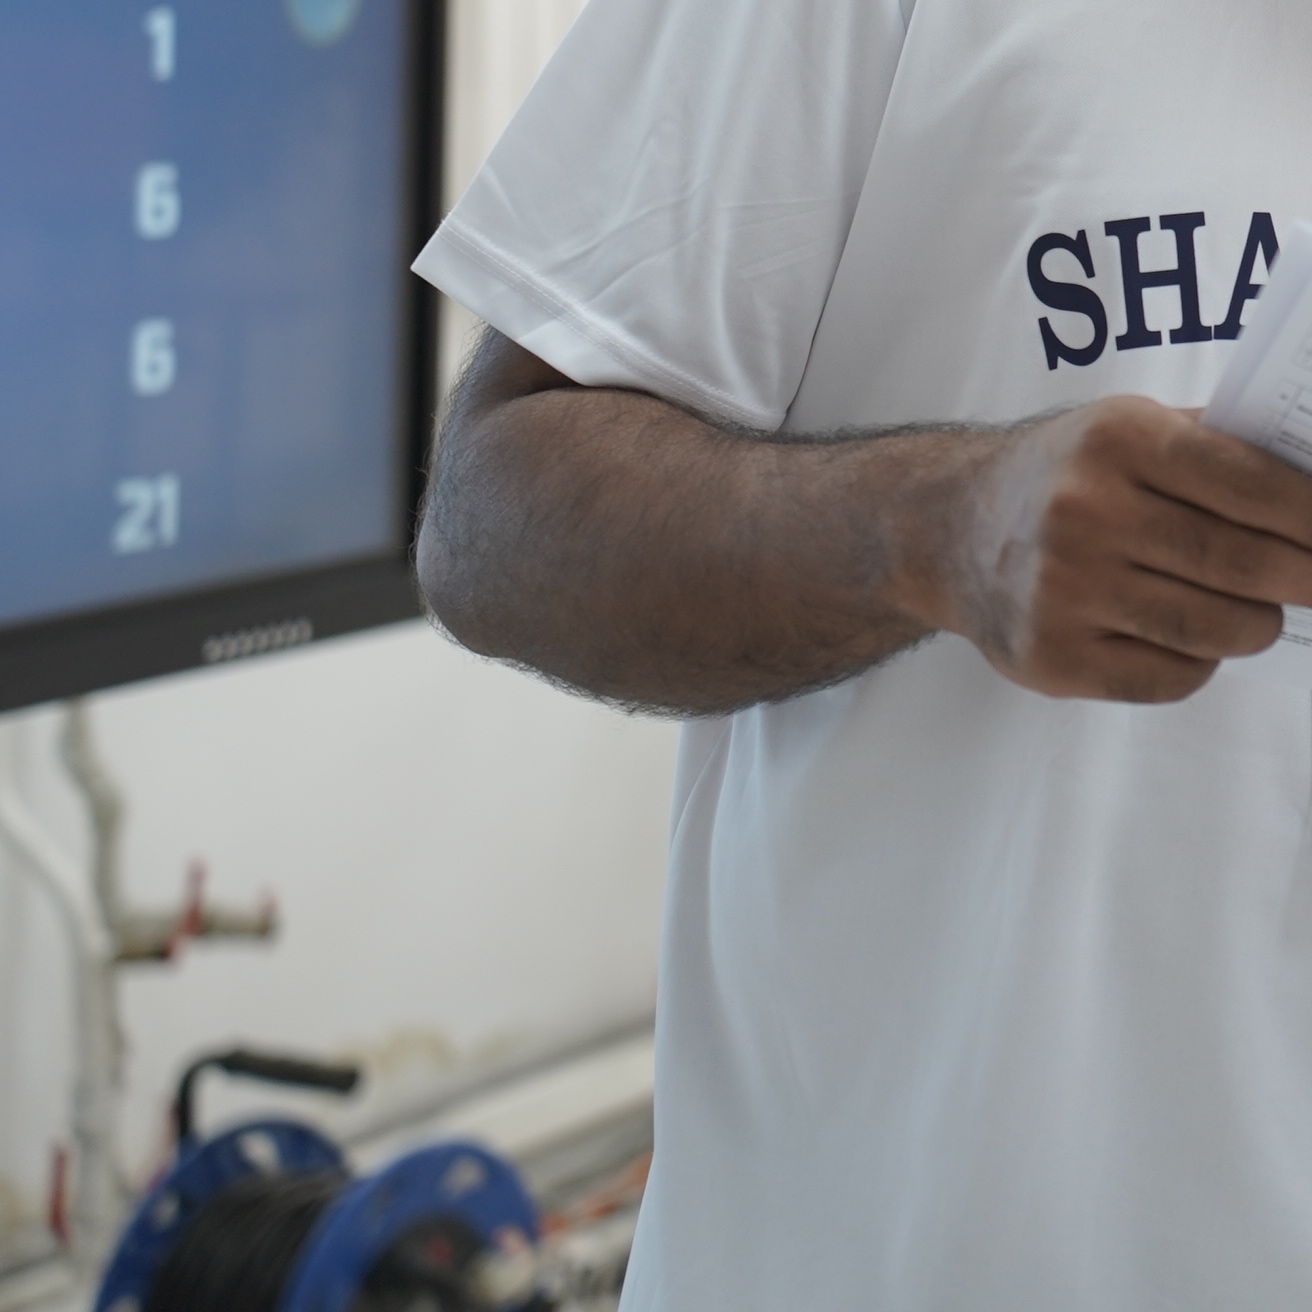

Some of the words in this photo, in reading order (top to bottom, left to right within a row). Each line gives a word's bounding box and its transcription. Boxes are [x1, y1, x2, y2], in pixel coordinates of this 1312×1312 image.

[146, 7, 176, 82] 1
[135, 163, 182, 241] 6
[131, 319, 177, 397] 6
[113, 473, 182, 555] 21
